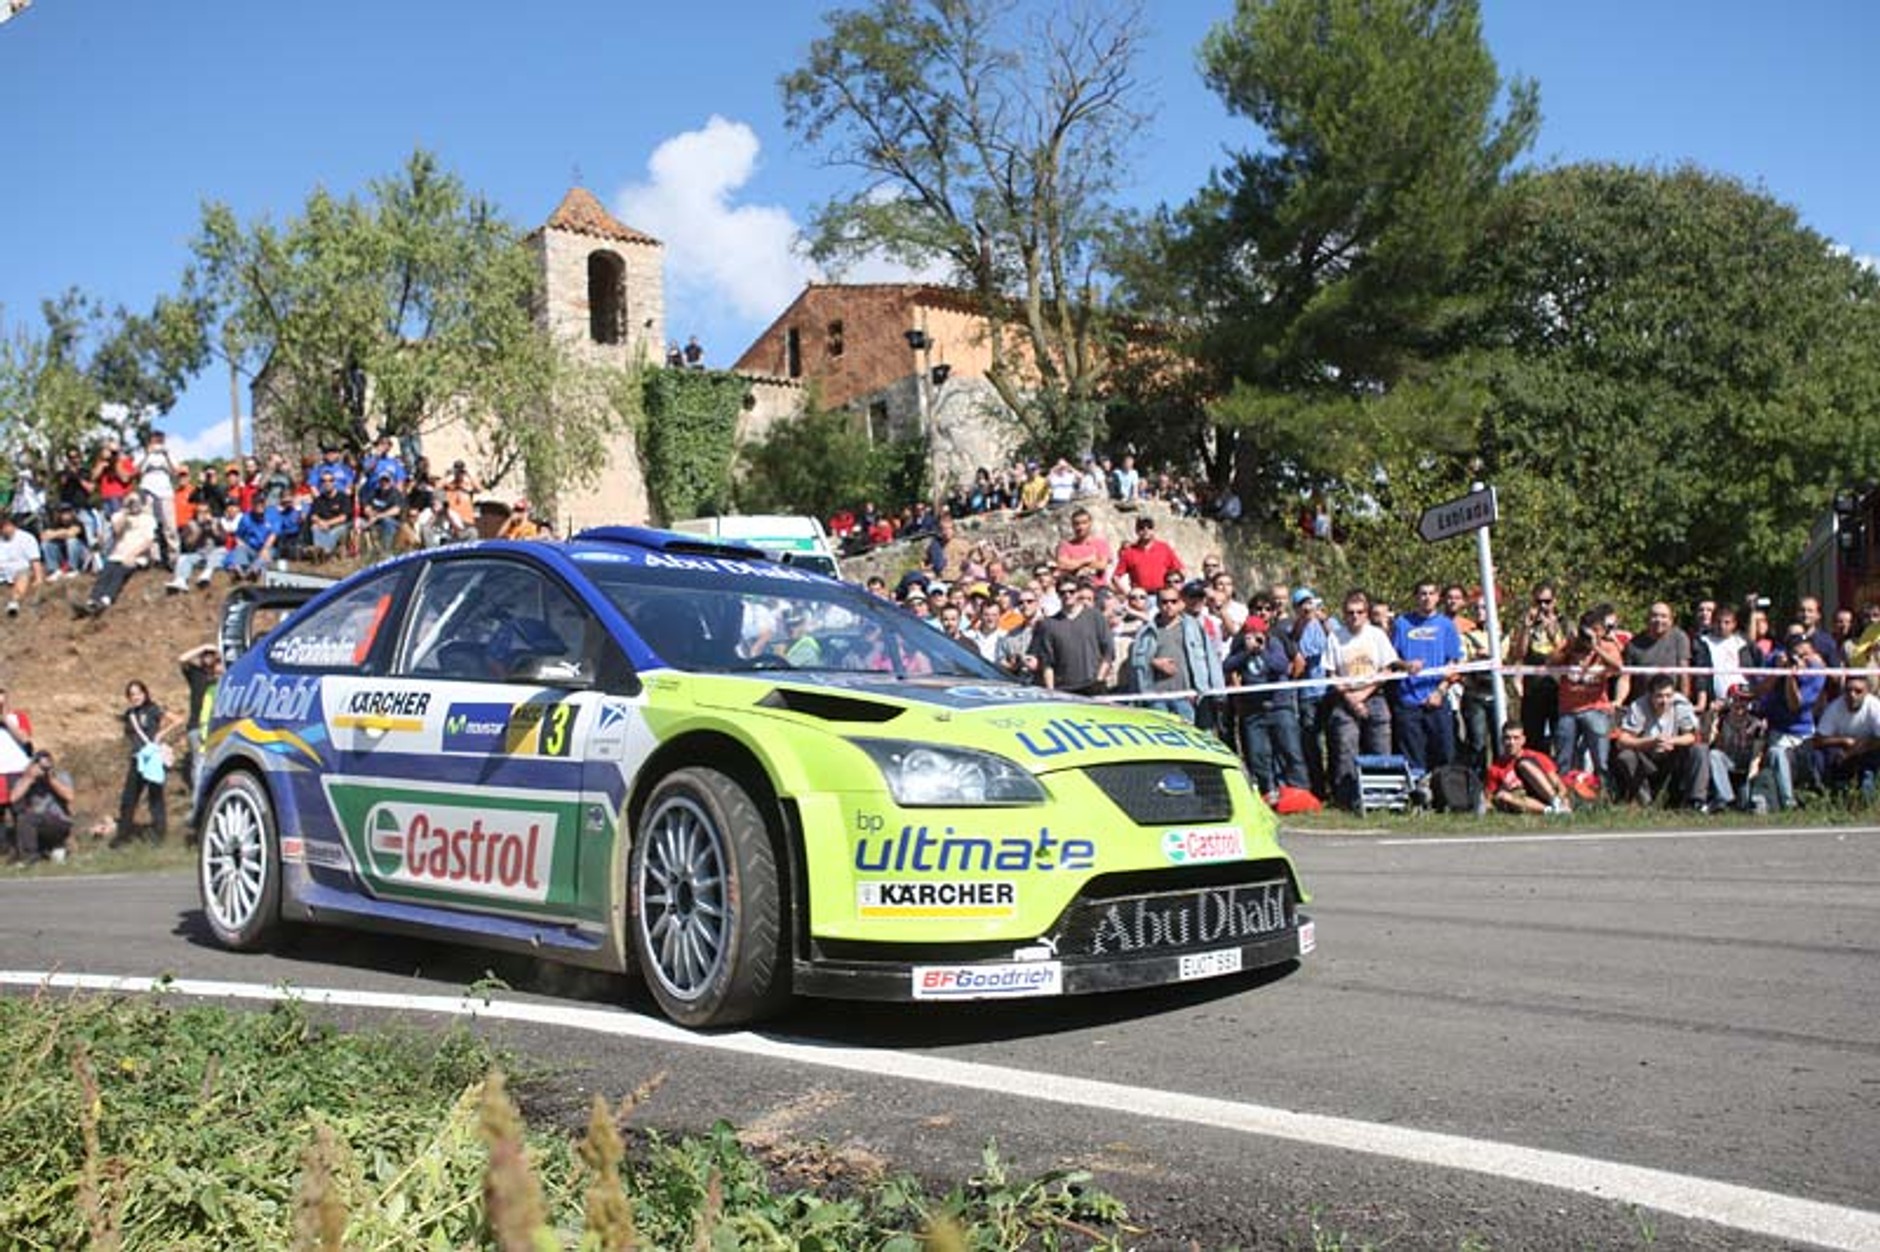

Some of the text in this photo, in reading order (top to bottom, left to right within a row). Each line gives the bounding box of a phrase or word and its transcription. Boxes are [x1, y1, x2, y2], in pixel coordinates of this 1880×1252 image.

[350, 691, 431, 716] KÄRCHER
[546, 702, 571, 756] 3
[1015, 718, 1232, 758] ultimate
[856, 810, 884, 834] bp
[406, 814, 540, 890] Castrol
[854, 826, 1094, 871] ultimate
[1187, 831, 1243, 858] Castrol
[880, 883, 1014, 904] KÄRCHER
[1091, 884, 1287, 955] Abu Dhabi
[922, 967, 1054, 989] BFGoodrich
